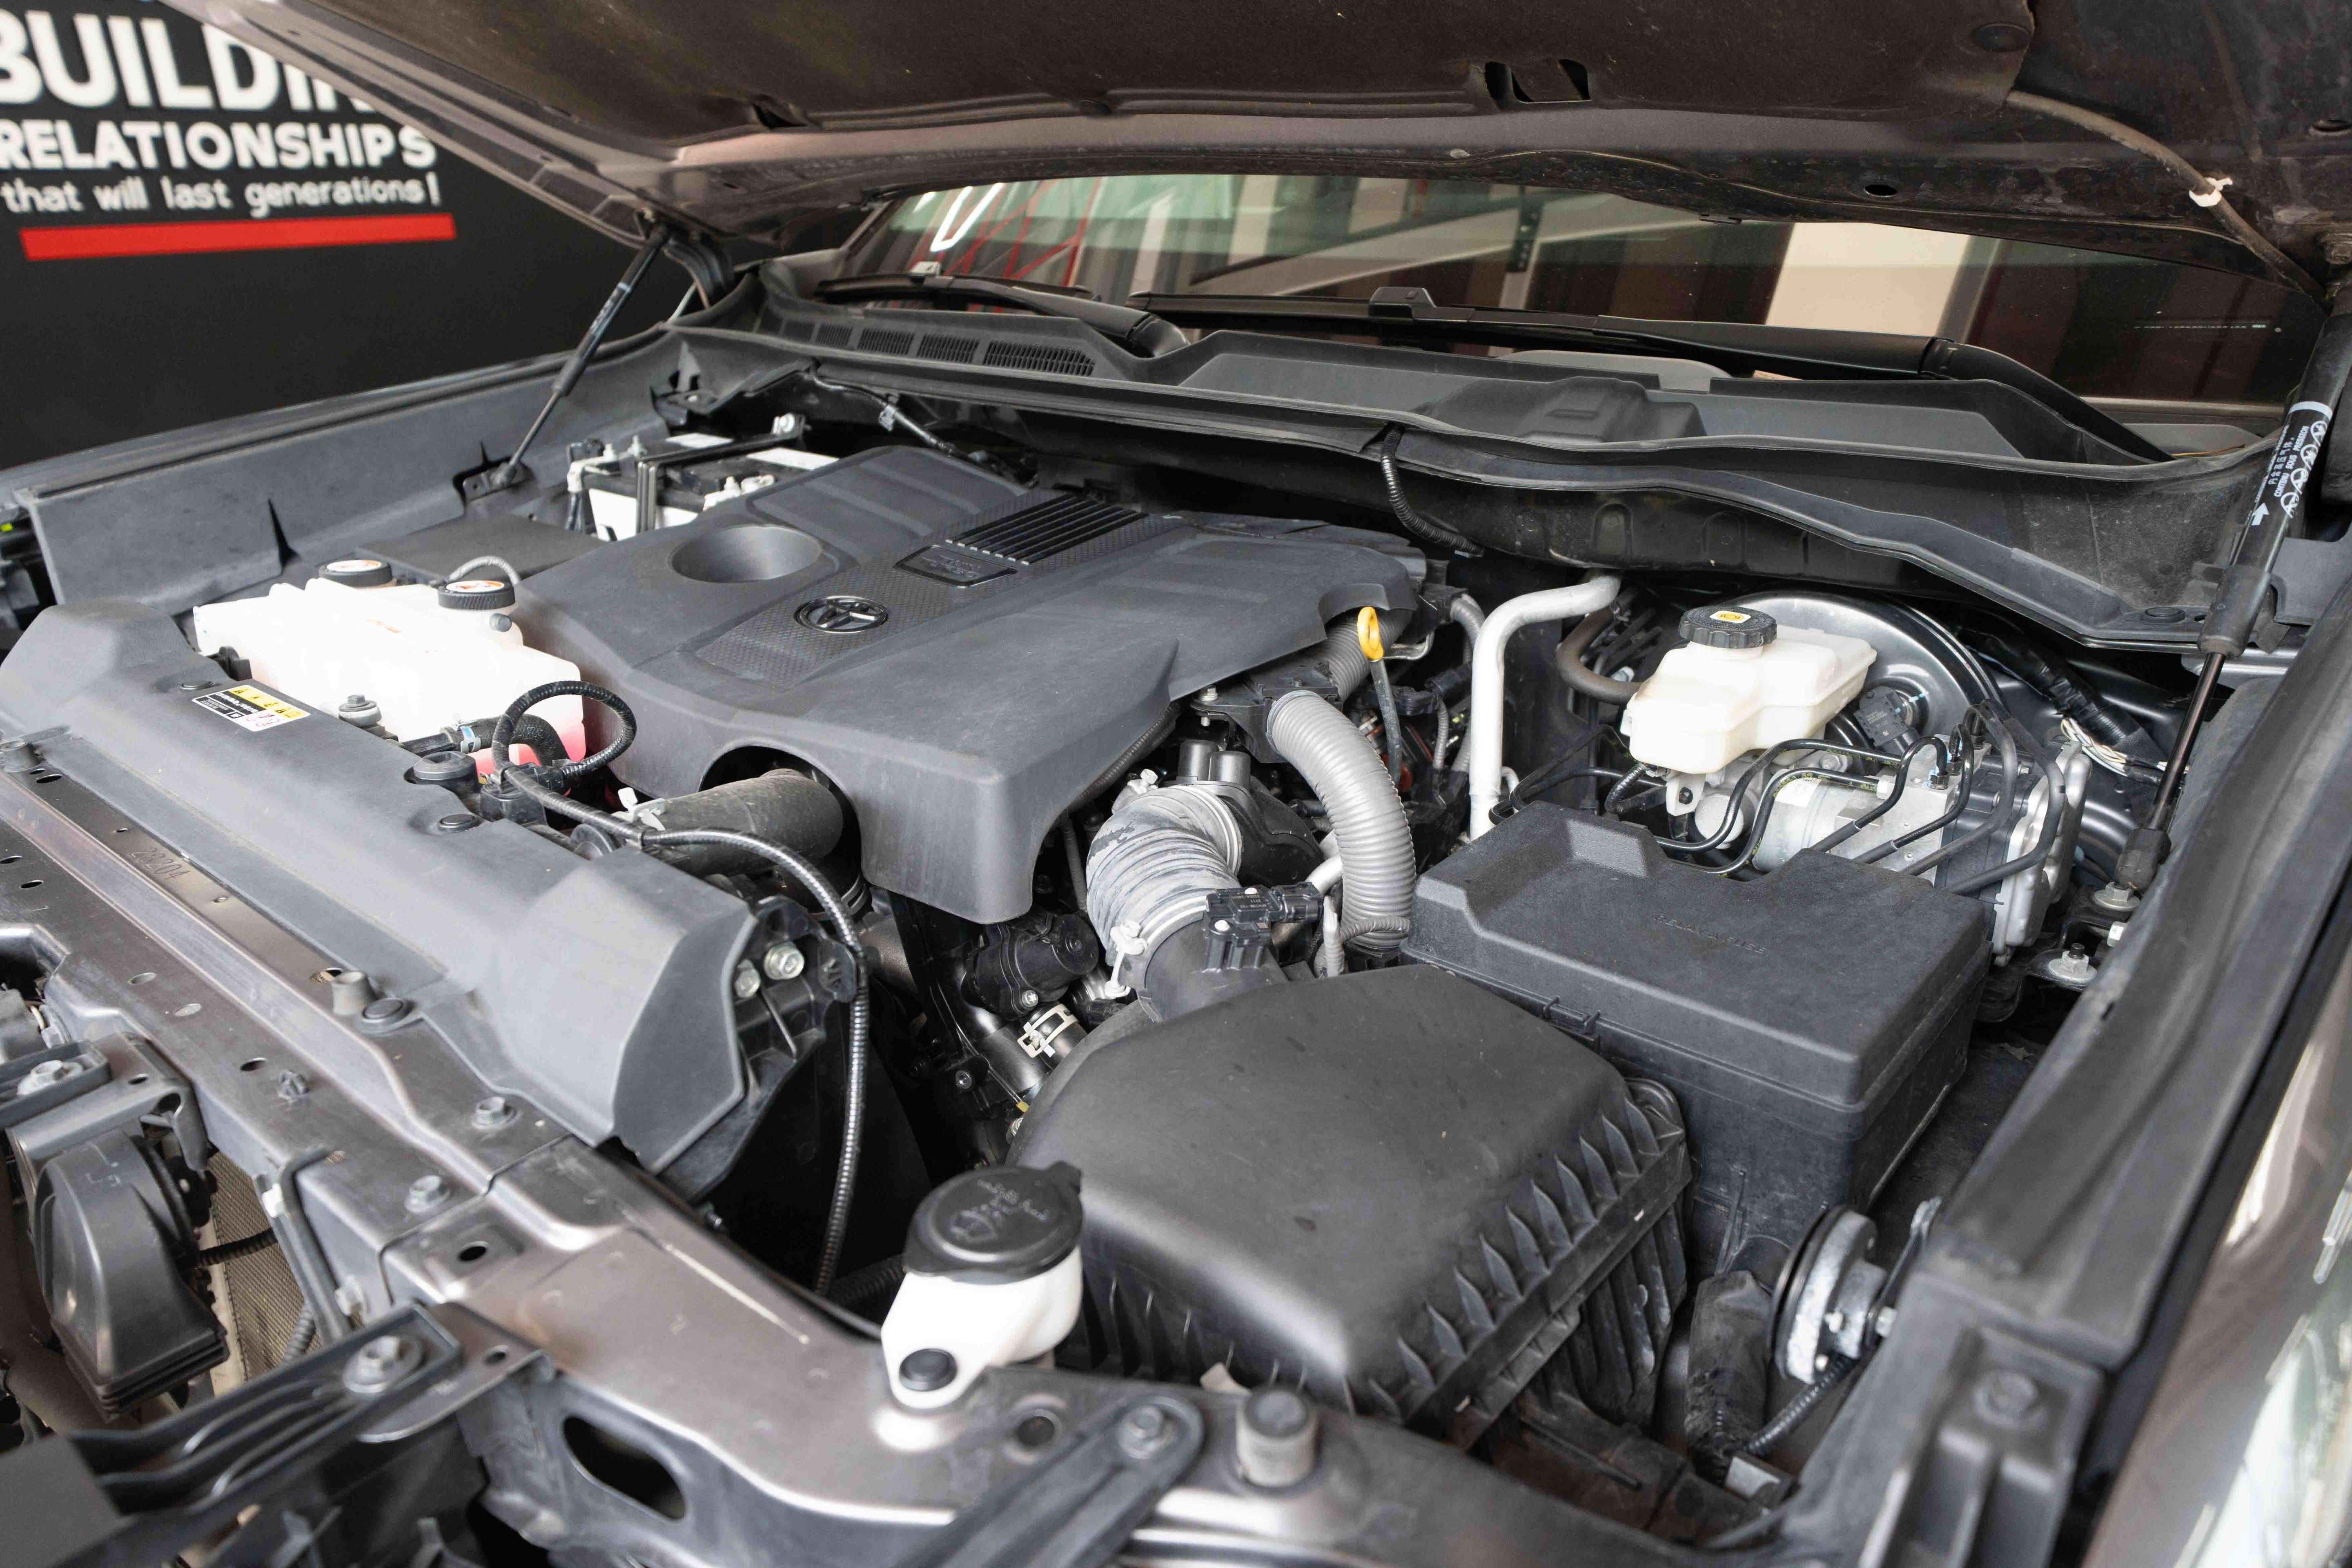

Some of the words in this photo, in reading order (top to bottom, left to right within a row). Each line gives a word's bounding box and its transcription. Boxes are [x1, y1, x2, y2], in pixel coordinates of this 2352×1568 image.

[0, 118, 437, 169] RELATIONSHIPS
[0, 177, 84, 213] that
[93, 176, 149, 211] will
[160, 175, 234, 209] last
[245, 172, 441, 218] generations!
[2285, 454, 2298, 470] SOUS
